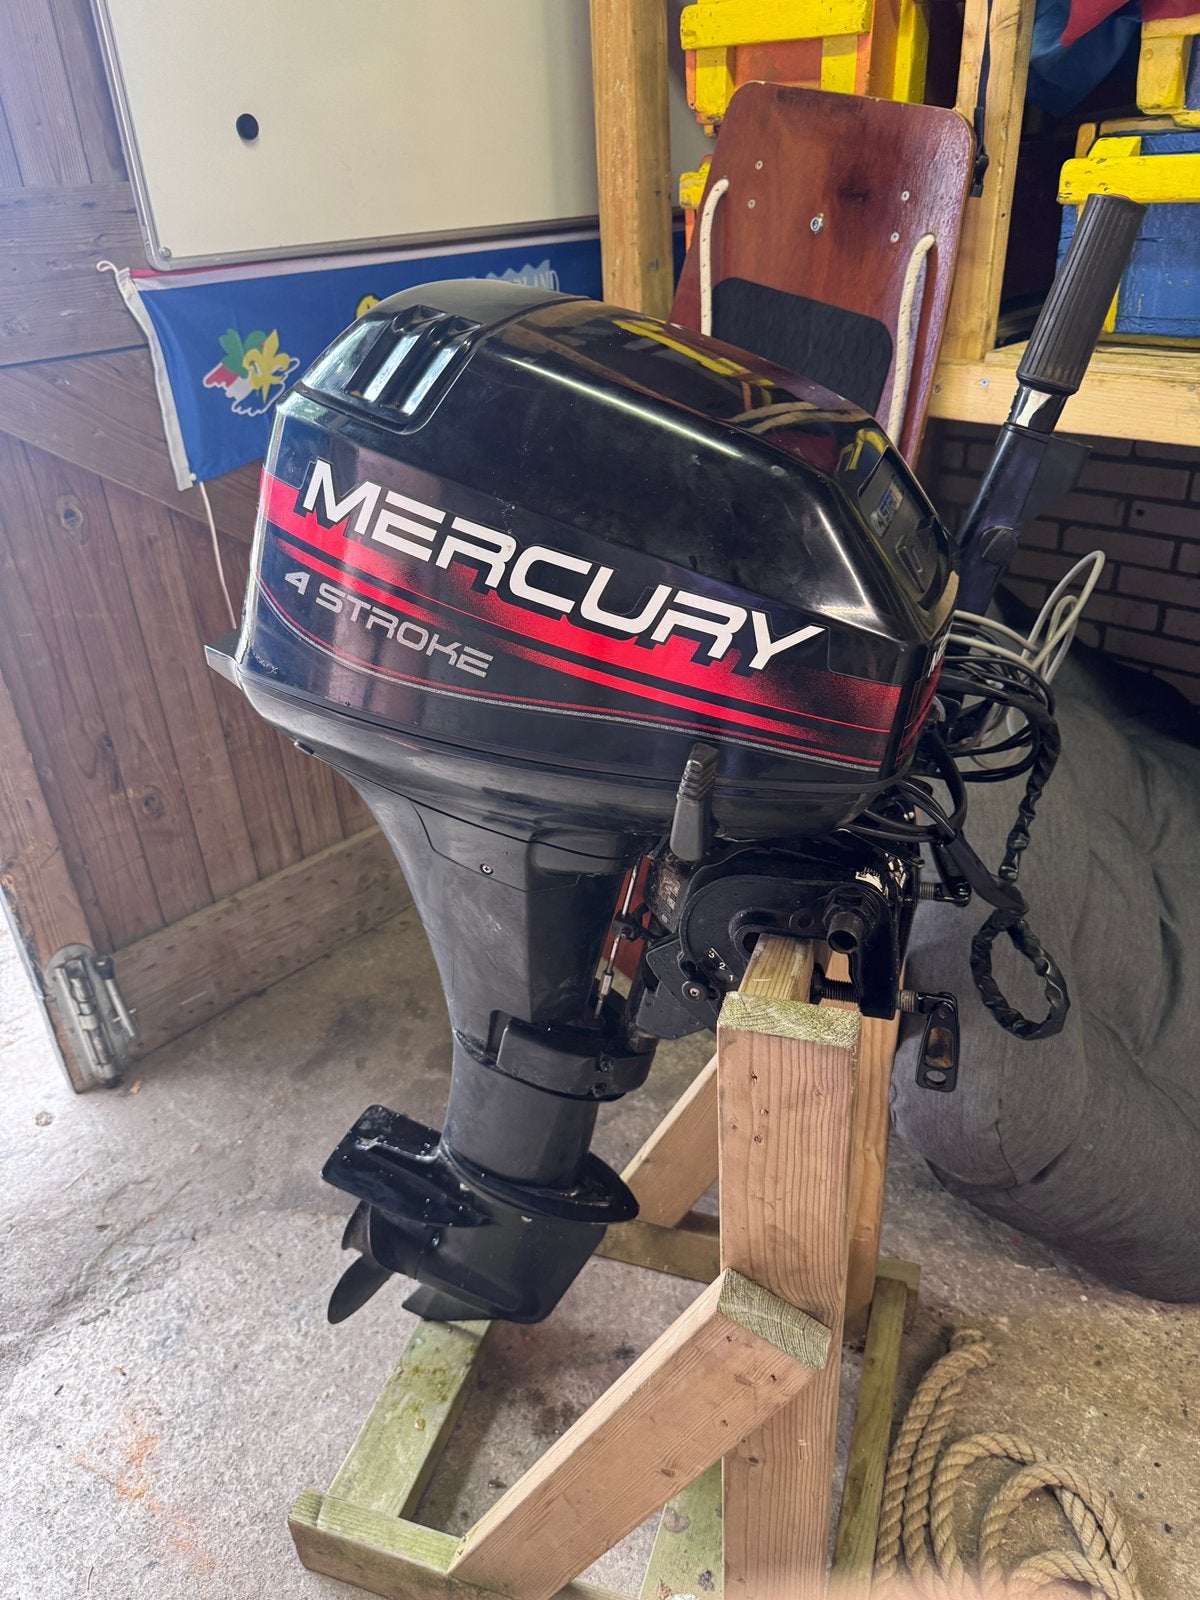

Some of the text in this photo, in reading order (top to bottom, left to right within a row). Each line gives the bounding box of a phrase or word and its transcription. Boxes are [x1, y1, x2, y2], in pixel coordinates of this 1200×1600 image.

[303, 458, 824, 670] MERCURY
[284, 571, 494, 678] 4 STROKE
[718, 962, 726, 971] 2
